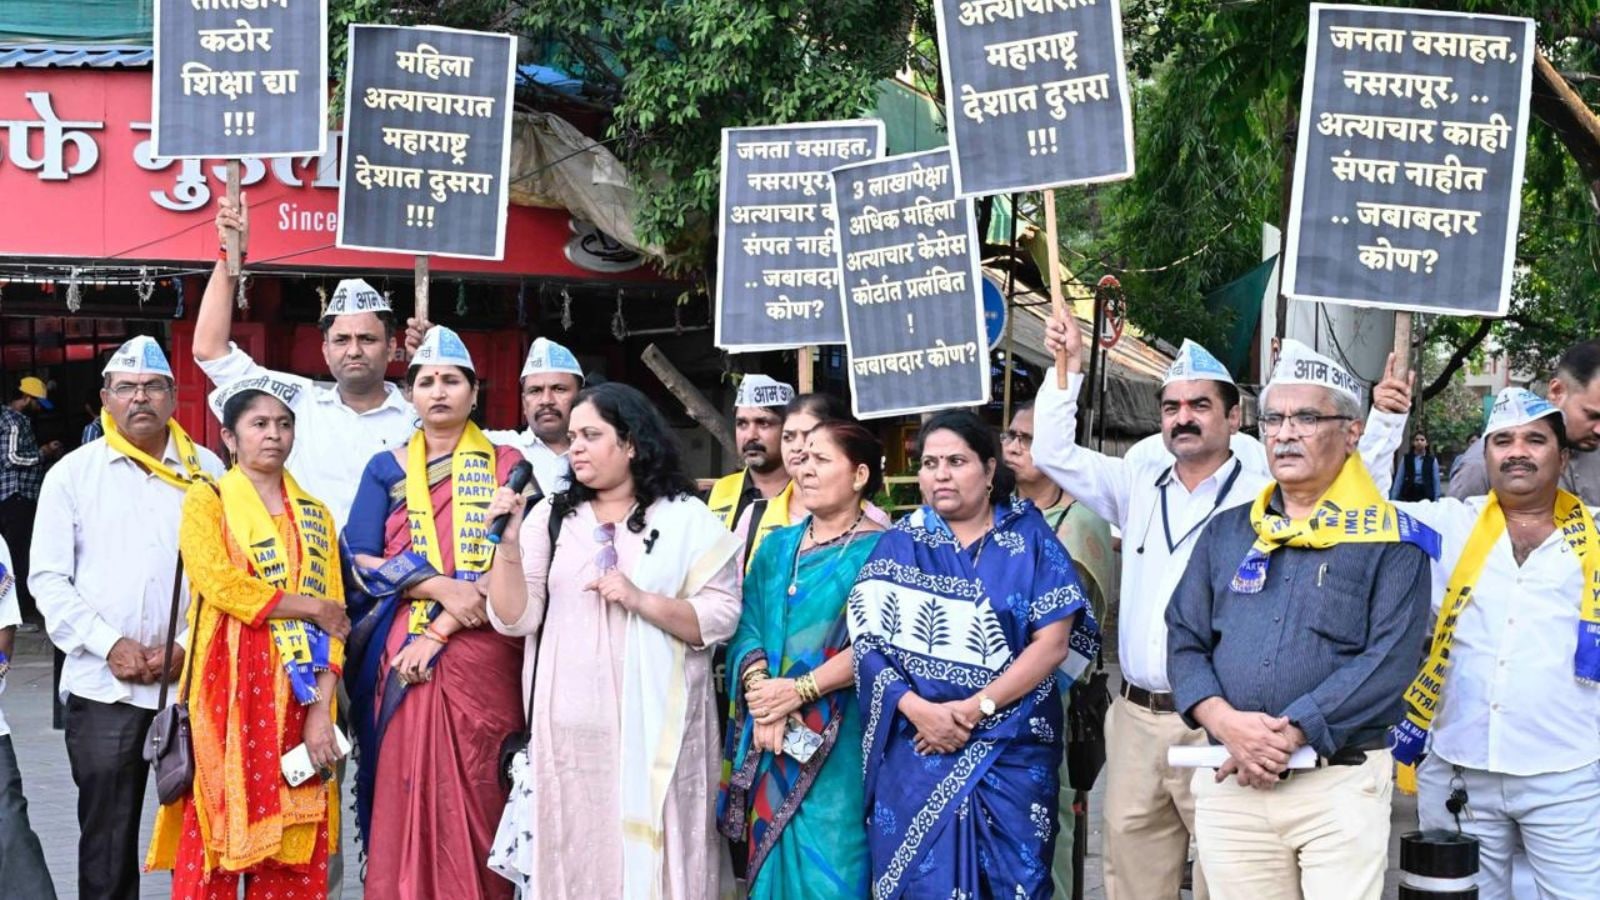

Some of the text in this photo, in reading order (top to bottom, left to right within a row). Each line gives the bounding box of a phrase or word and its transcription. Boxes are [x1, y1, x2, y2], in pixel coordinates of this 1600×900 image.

[197, 18, 274, 52] कठोर
[983, 30, 1079, 71] महाराष्ट्र
[1329, 25, 1518, 64] जनता वसाहत,
[395, 43, 474, 80] महिला
[180, 61, 300, 101] शिक्षा द्या
[1342, 70, 1459, 109] नसरापूर,
[363, 87, 496, 118] अत्याचारात
[960, 73, 1110, 124] देशात दुसरा
[0, 92, 104, 181] फे
[223, 111, 255, 136] !!!
[1316, 112, 1513, 154] अत्याचार काही
[381, 127, 471, 165] महाराष्ट्र
[736, 138, 872, 160] जनता वसाहत,
[1027, 126, 1058, 156] !!!
[354, 154, 494, 203] देशात दुसरा
[853, 160, 950, 200] 3 लाखापेक्षा
[1330, 149, 1488, 195] संपत नाहीत
[278, 203, 338, 233] Since
[406, 204, 435, 228] !!!
[730, 203, 818, 224] अत्याचार
[849, 207, 900, 236] अधिक
[901, 195, 957, 227] महिला
[1356, 201, 1482, 238] जबाबदार
[741, 232, 793, 256] संपत
[846, 229, 967, 272] अत्याचार केसेस
[1357, 237, 1439, 274] कोण?
[762, 268, 838, 291] जबाबदा
[850, 265, 967, 306] कोर्टात प्रलंबित
[764, 294, 825, 320] कोण?
[852, 338, 977, 380] जबाबदार कोण?
[1294, 359, 1329, 383] आम
[271, 379, 302, 404] पार्टी
[754, 385, 779, 404] आम
[458, 472, 494, 485] AADMI
[464, 458, 489, 470] AAM
[458, 485, 495, 498] PARTY
[1562, 522, 1586, 536] AAD
[460, 543, 493, 556] PARTY
